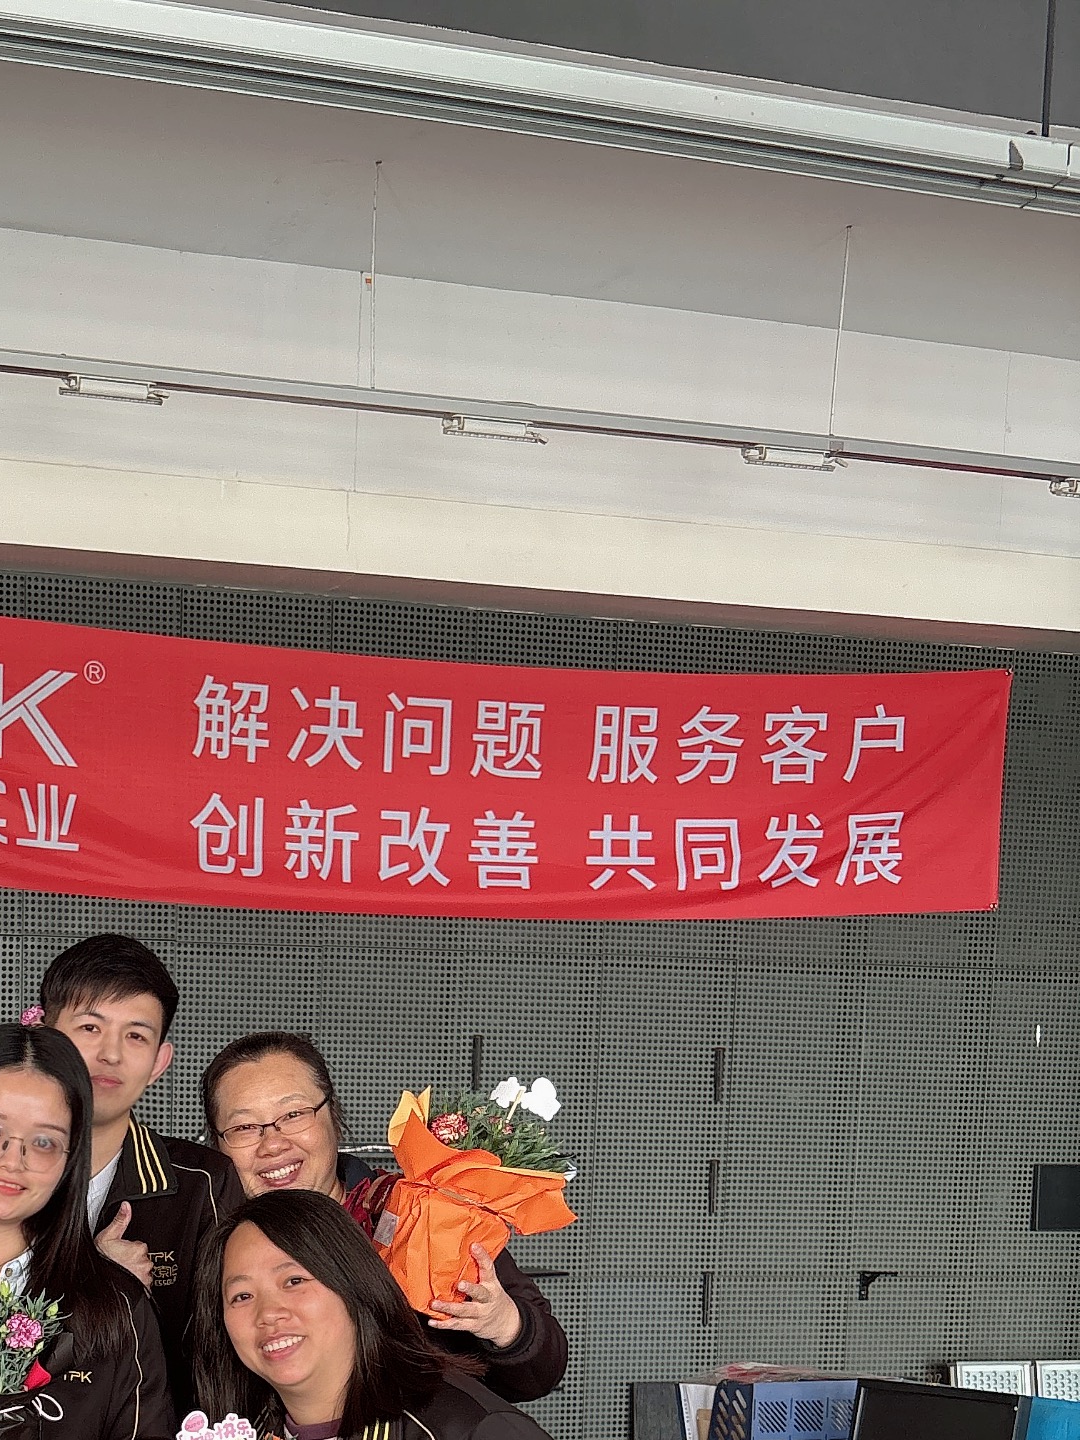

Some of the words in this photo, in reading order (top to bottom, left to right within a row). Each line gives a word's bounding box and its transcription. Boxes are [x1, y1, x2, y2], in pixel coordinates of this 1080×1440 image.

[191, 674, 544, 779] 解决问题
[587, 705, 907, 785] 服务客户
[189, 792, 540, 890] 创新改善
[586, 811, 906, 891] 共同发展
